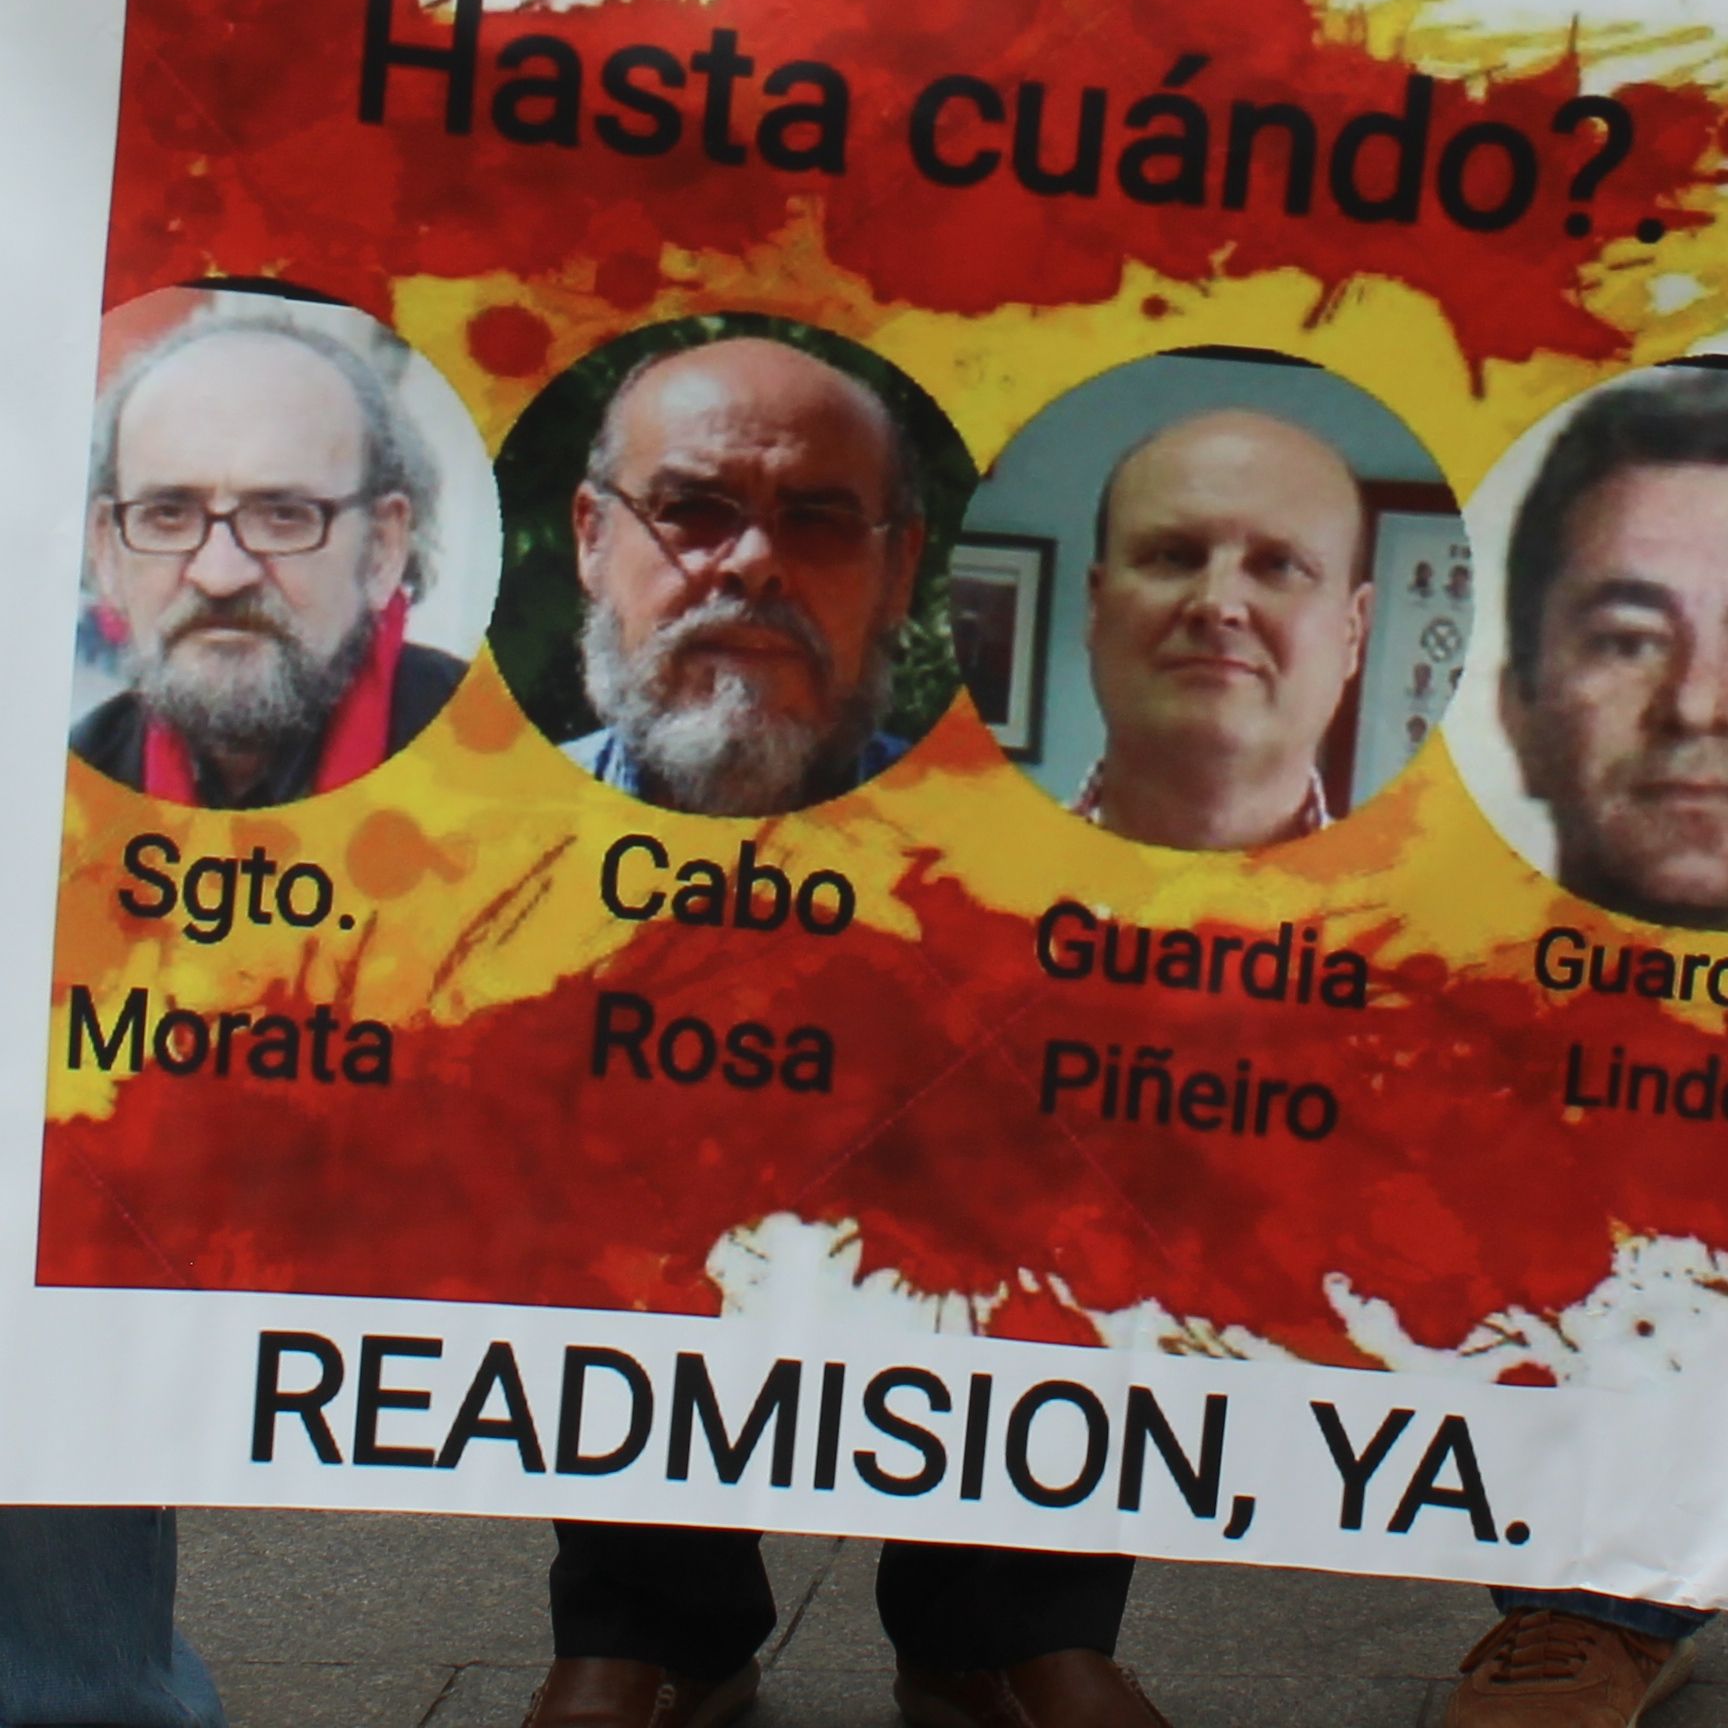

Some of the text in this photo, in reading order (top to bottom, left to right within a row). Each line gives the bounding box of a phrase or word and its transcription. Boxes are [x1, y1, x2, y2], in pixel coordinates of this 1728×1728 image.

[117, 834, 360, 944] Sgto.
[598, 834, 858, 940] Cabo
[1033, 902, 1370, 1012] Guardia
[65, 984, 394, 1088] Morata
[590, 990, 836, 1095] Rosa
[1038, 1037, 1343, 1150] Piñeiro
[251, 1328, 1535, 1548] READMISION, YA.
